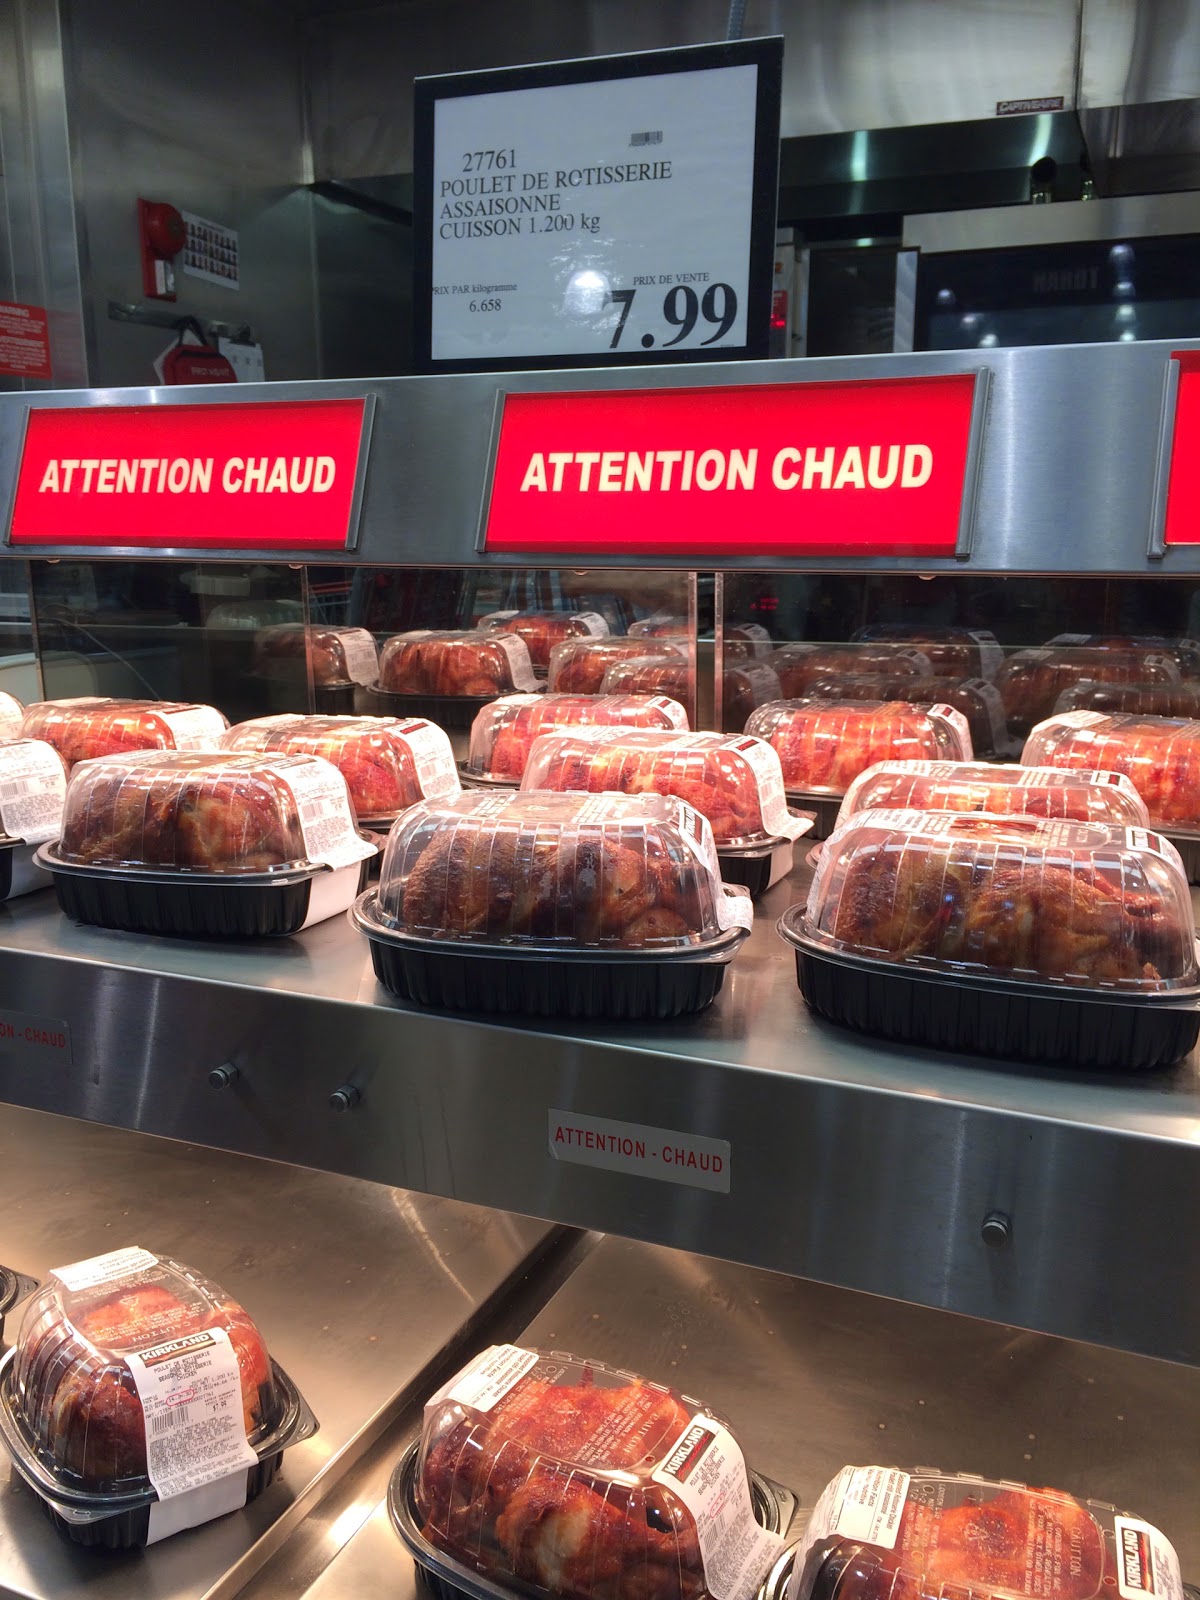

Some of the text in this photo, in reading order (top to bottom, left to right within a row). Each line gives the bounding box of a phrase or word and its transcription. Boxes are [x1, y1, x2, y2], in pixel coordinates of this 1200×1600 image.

[462, 149, 517, 173] 27761
[440, 161, 673, 198] POULET DE ROTISSERIE
[440, 195, 561, 219] ASSAISONNE
[439, 213, 601, 240] CUISSON 1.200 kg
[452, 286, 470, 294] PAR
[633, 272, 710, 285] PRIX DE VENTE
[469, 299, 502, 312] 6.658
[604, 283, 738, 349] 7.99
[39, 456, 337, 493] ATTENTION CHAUD
[519, 444, 934, 492] ATTENTION CHAUD
[24, 1026, 66, 1048] CHAUD
[555, 1126, 646, 1158] ATTENTION
[662, 1146, 723, 1173] CHAUD
[132, 1321, 191, 1342] CAUTION
[142, 1333, 210, 1360] KIRKLAND
[623, 1412, 660, 1454] CAUTION
[666, 1426, 705, 1475] KIRKLAND
[1070, 1527, 1081, 1577] CAUTION
[1124, 1530, 1142, 1587] KIRKLAND
